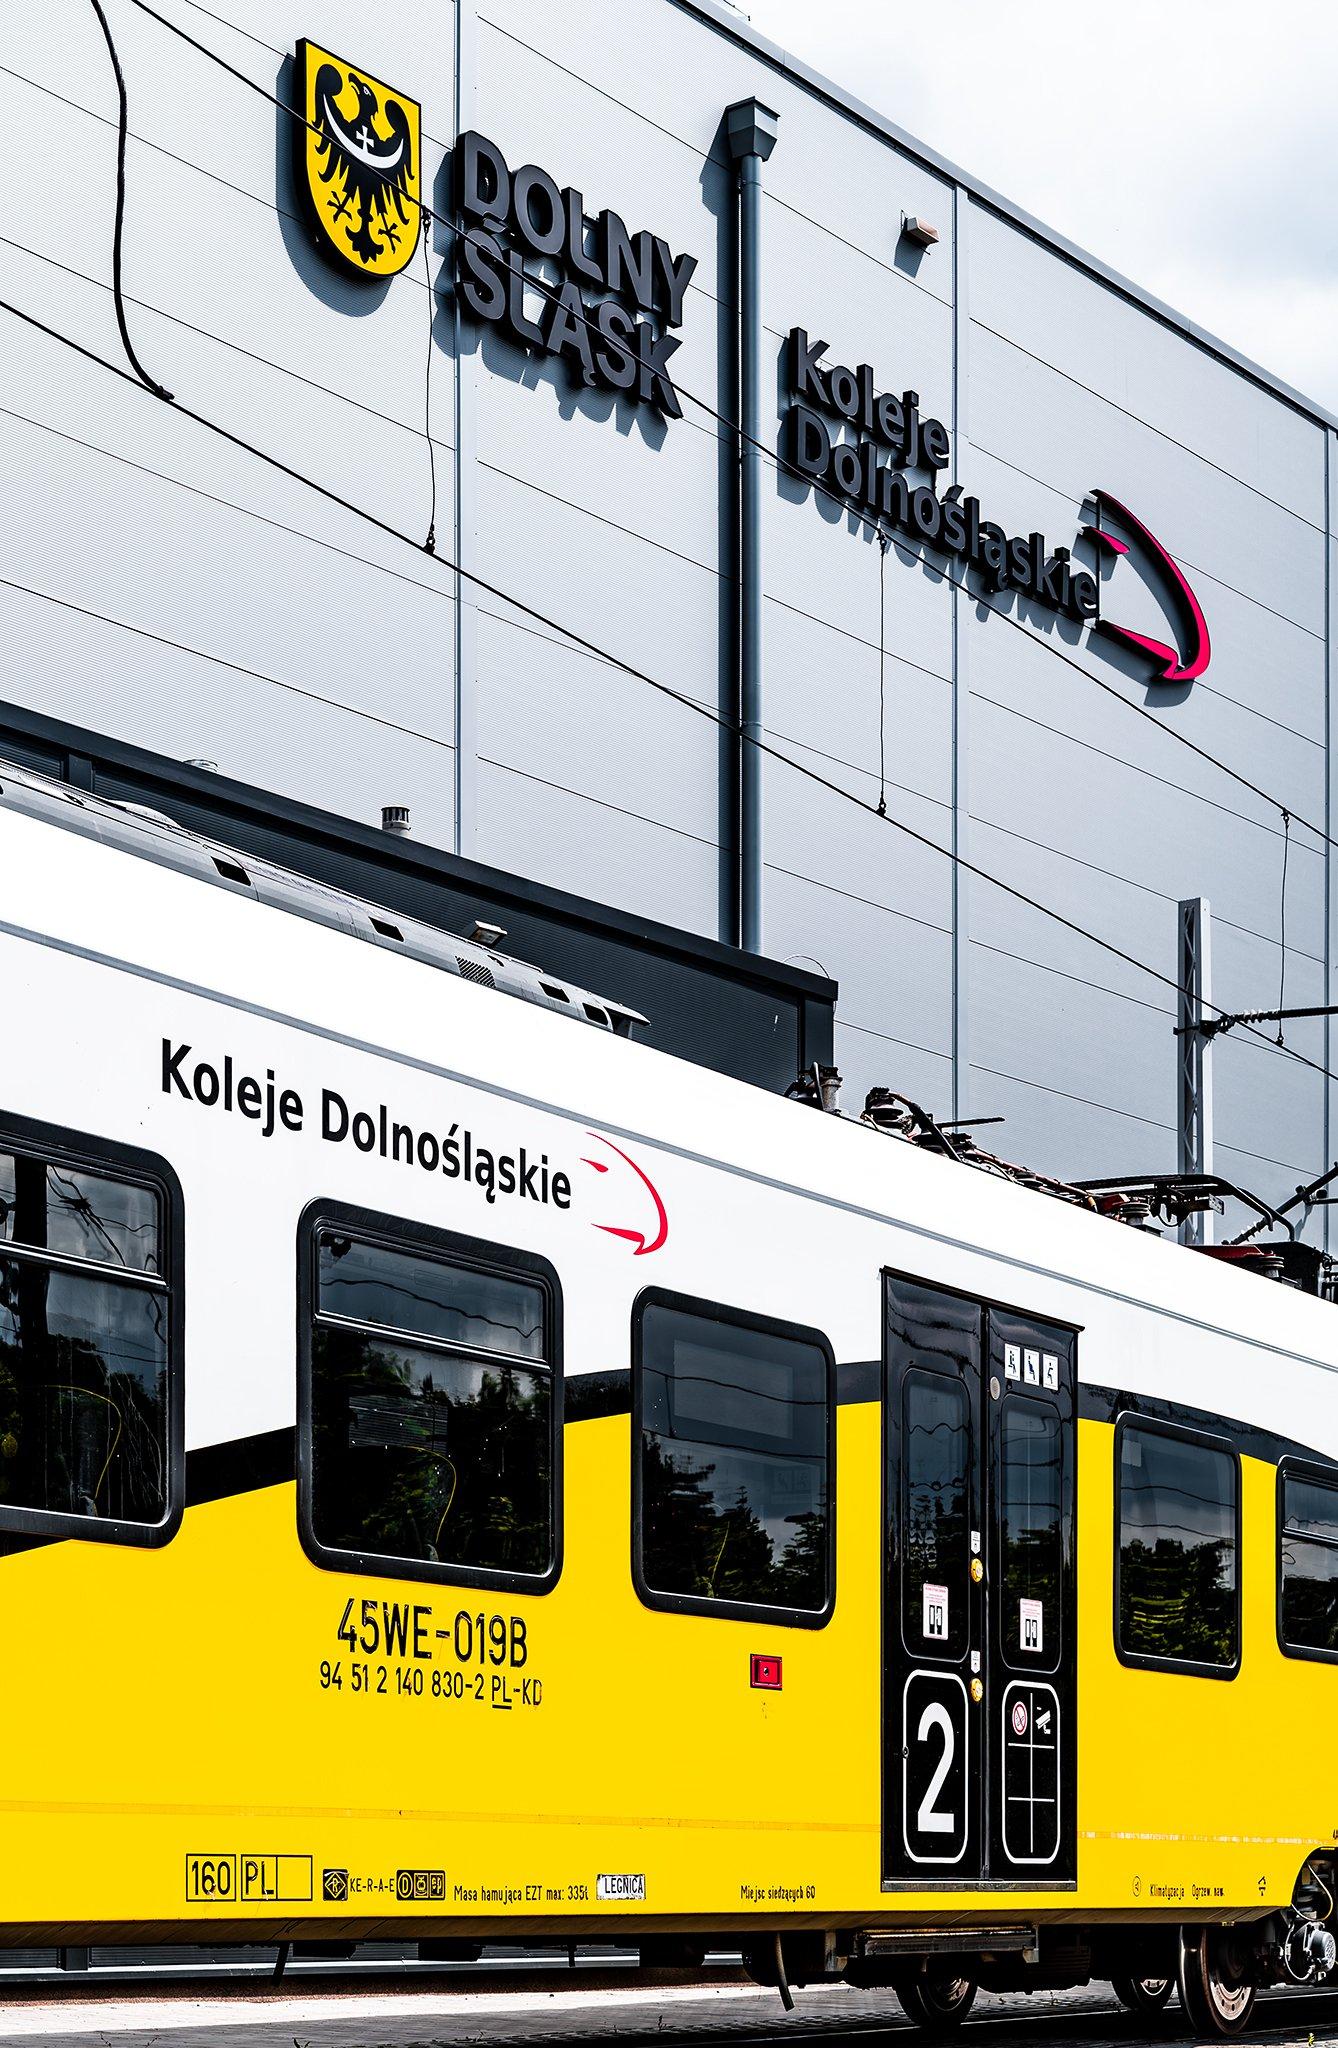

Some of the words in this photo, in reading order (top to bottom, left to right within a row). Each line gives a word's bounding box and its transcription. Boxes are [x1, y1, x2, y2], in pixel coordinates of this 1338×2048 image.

[455, 130, 698, 329] DOLNY
[454, 213, 684, 419] ŚLĄSK
[790, 327, 950, 469] Koleje
[787, 405, 1100, 620] Dolnośląskie
[161, 1038, 303, 1138] Koleje
[321, 1088, 572, 1209] Dolnośląskie
[337, 1598, 528, 1668] 45WE-019B
[320, 1661, 342, 1690] 94
[351, 1663, 369, 1692] 51
[376, 1665, 388, 1693] 2
[396, 1667, 423, 1696] 140
[431, 1670, 485, 1700] 830-2
[492, 1675, 543, 1708] PL-KD
[917, 1702, 955, 1833] 2
[192, 1860, 231, 1896] 160
[245, 1860, 275, 1896] PL
[350, 1878, 395, 1893] KE-R-A-E
[454, 1885, 478, 1901] Masa
[481, 1885, 522, 1905] hamująca
[525, 1885, 543, 1901] EZT
[546, 1888, 565, 1901] max:
[567, 1885, 589, 1901] 335t
[604, 1877, 644, 1895] LEGNICA
[740, 1885, 765, 1902] Miejsc
[805, 1885, 816, 1899] 60
